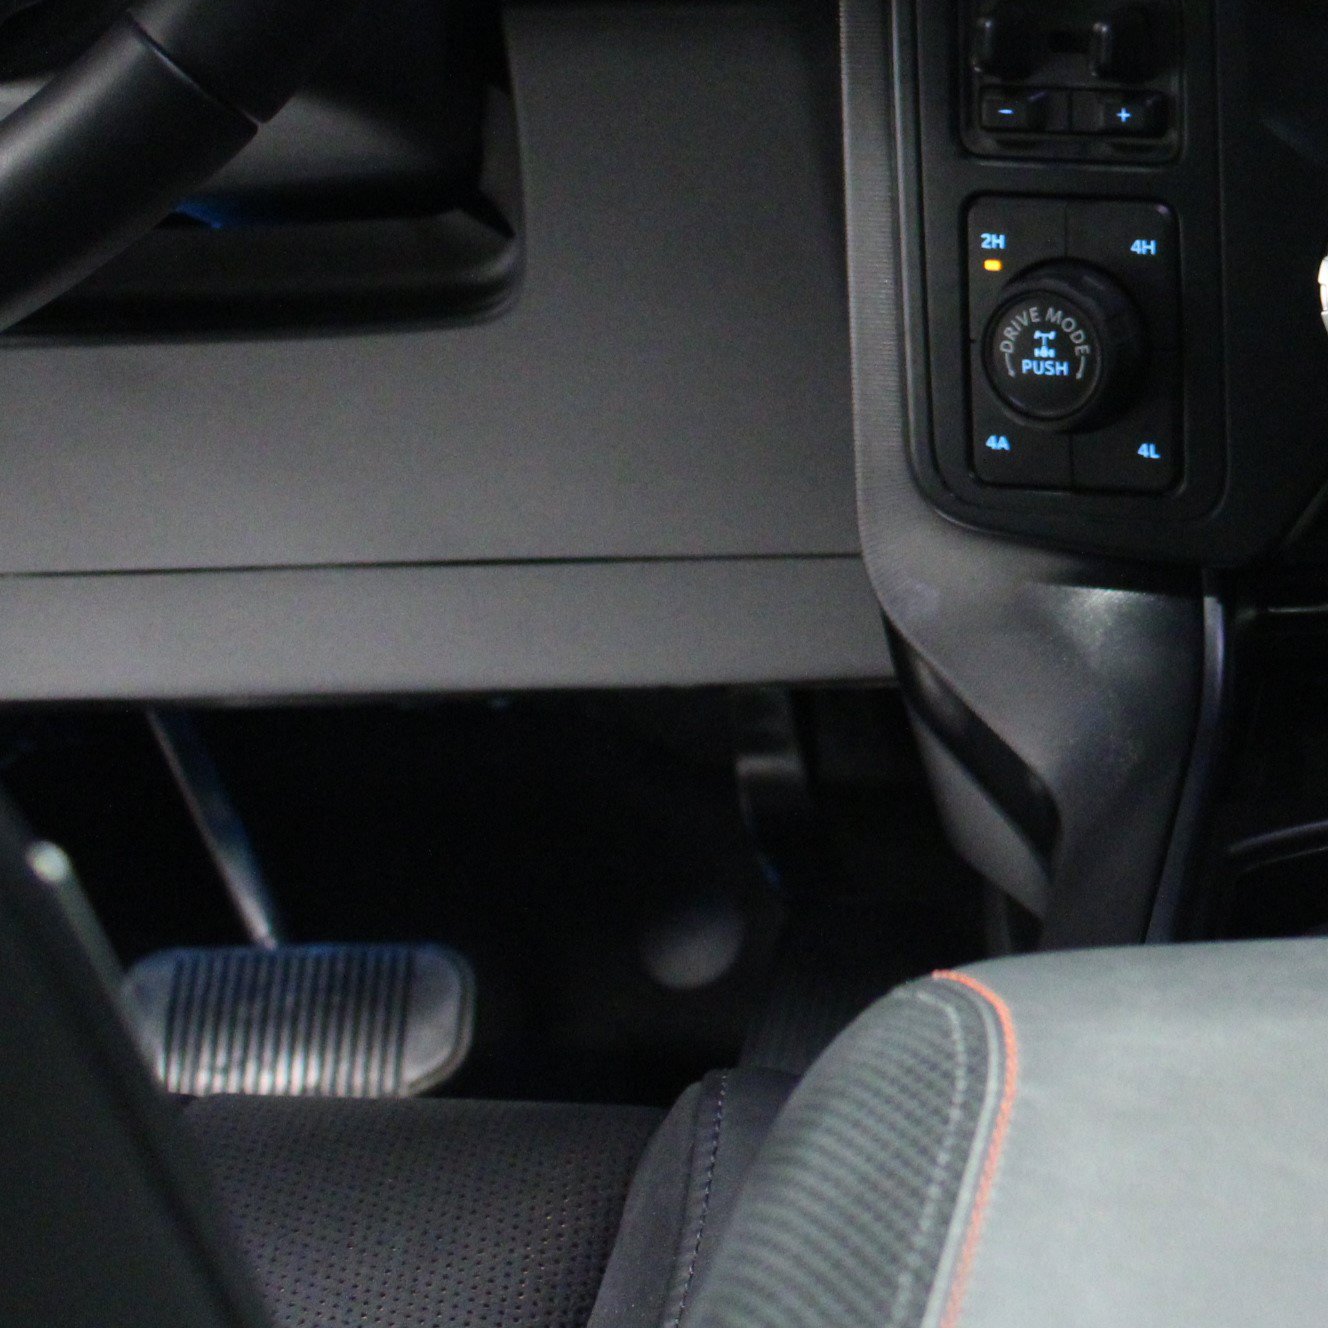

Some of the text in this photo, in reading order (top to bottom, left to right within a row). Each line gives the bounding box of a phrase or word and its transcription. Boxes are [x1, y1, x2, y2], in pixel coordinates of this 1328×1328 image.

[980, 233, 1006, 249] 2H
[1130, 239, 1157, 256] 4H
[1000, 307, 1090, 356] DRIVE MODE
[1022, 359, 1068, 376] PUSH
[985, 435, 1010, 451] 4A
[1138, 443, 1160, 459] 4L
